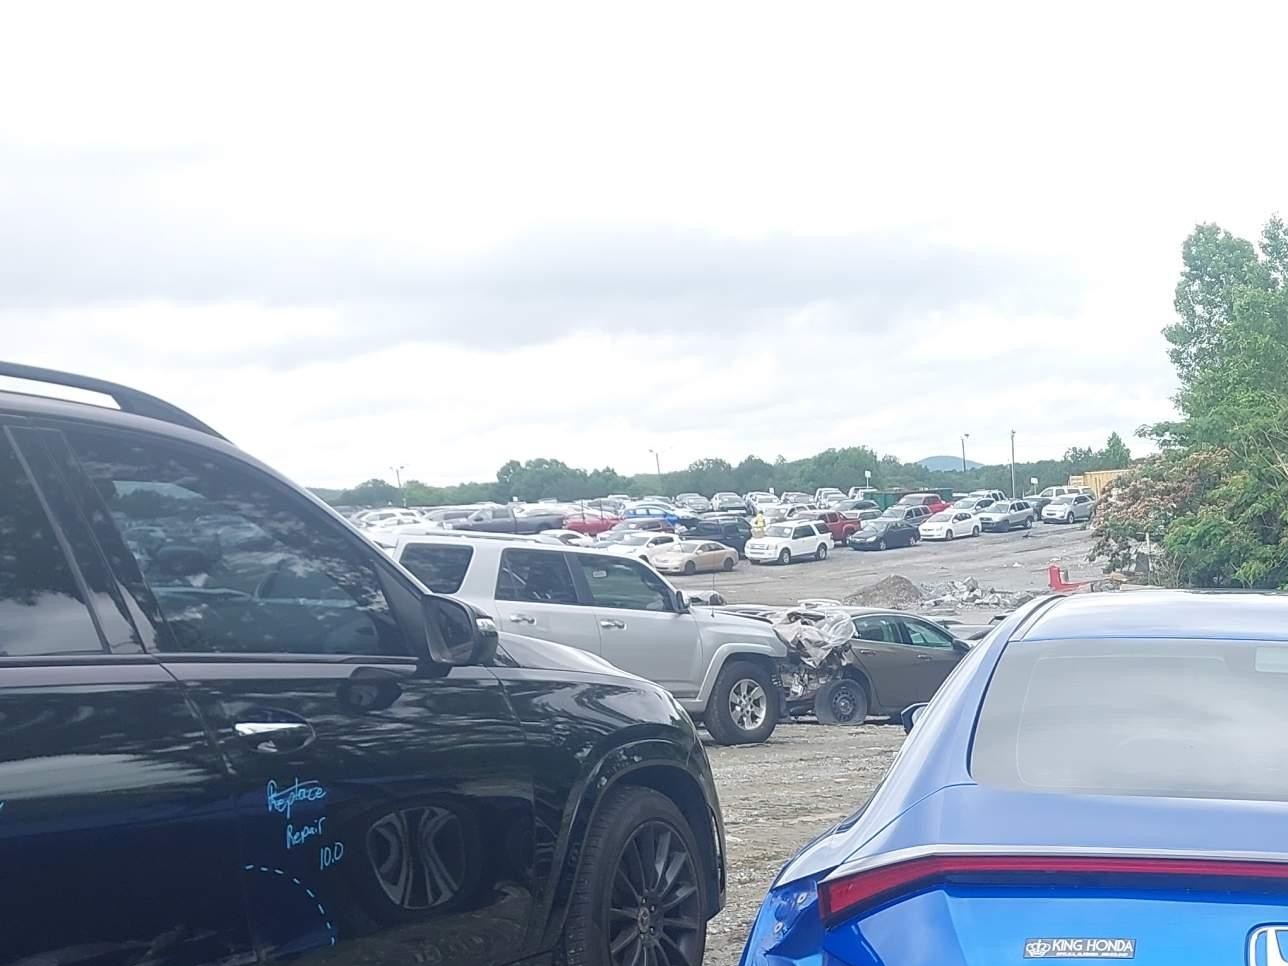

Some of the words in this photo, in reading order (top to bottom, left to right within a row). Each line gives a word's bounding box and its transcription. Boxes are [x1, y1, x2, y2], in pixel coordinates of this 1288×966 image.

[267, 777, 327, 819] Replace
[286, 817, 326, 849] Repair
[320, 842, 344, 871] 10.0
[1052, 939, 1084, 952] KING
[1086, 939, 1134, 953] HONDA
